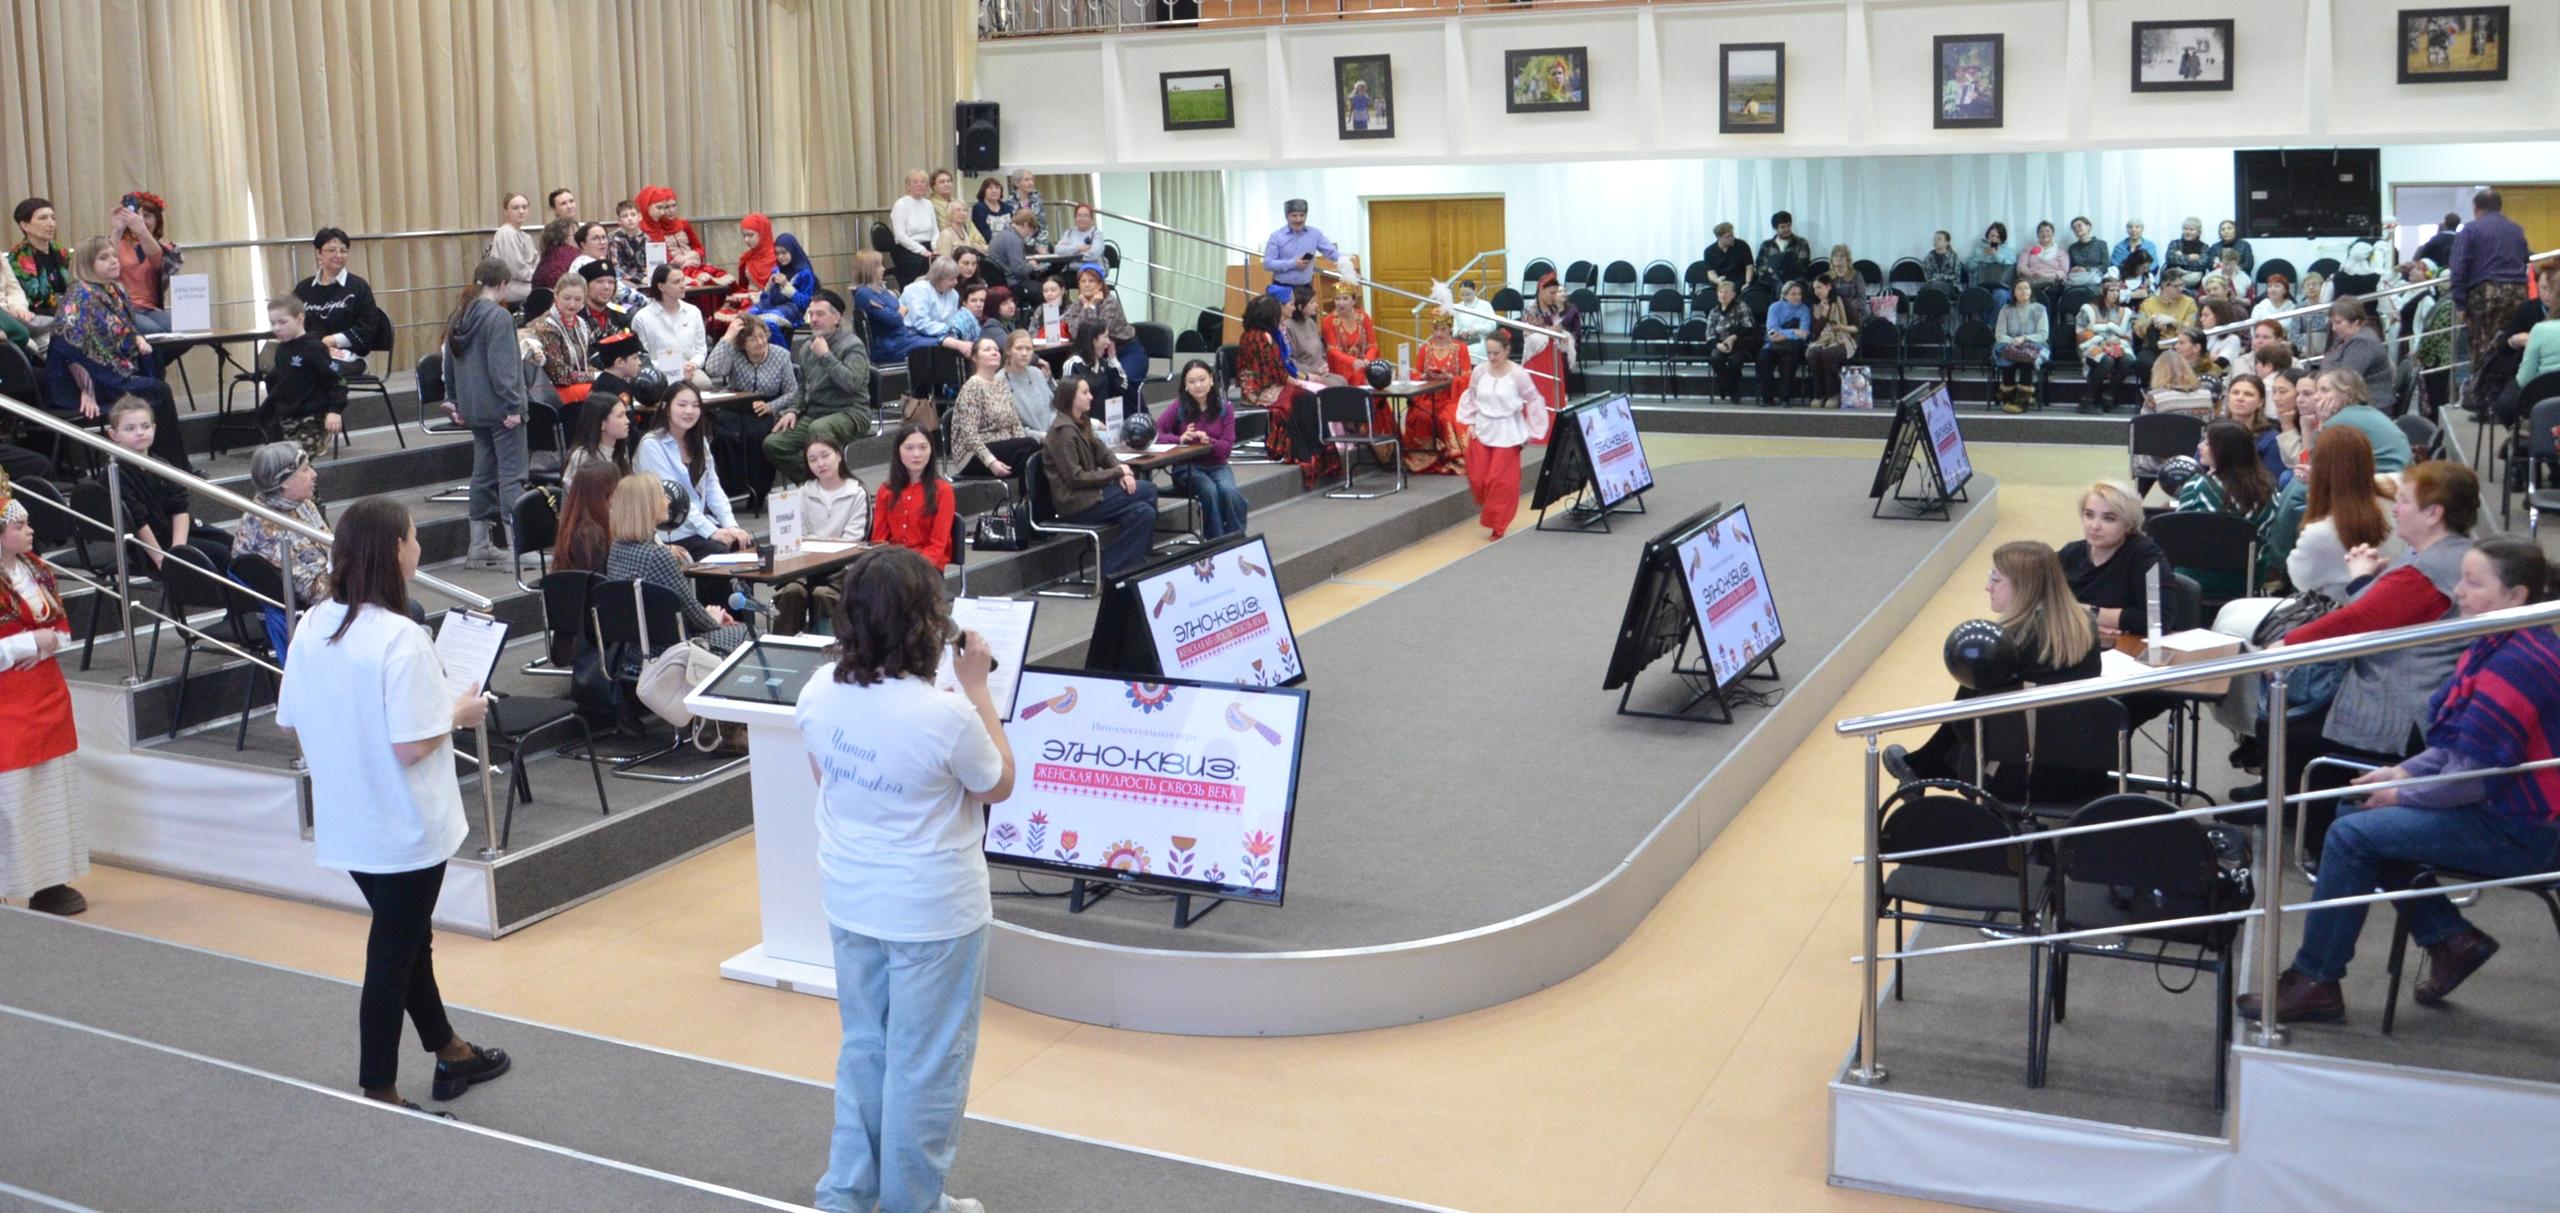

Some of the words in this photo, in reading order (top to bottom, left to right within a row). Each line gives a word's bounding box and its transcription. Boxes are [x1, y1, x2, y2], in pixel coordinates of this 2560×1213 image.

[827, 726, 877, 763] Читай
[1042, 739, 1242, 781] ЭТНО-КВИЗ:
[1036, 765, 1092, 783] ЖЕНСКАЯ
[1093, 773, 1157, 791] МУДРОСТЬ
[1159, 779, 1205, 797] СКВОЗЬ
[1208, 786, 1238, 800] ВЕКА
